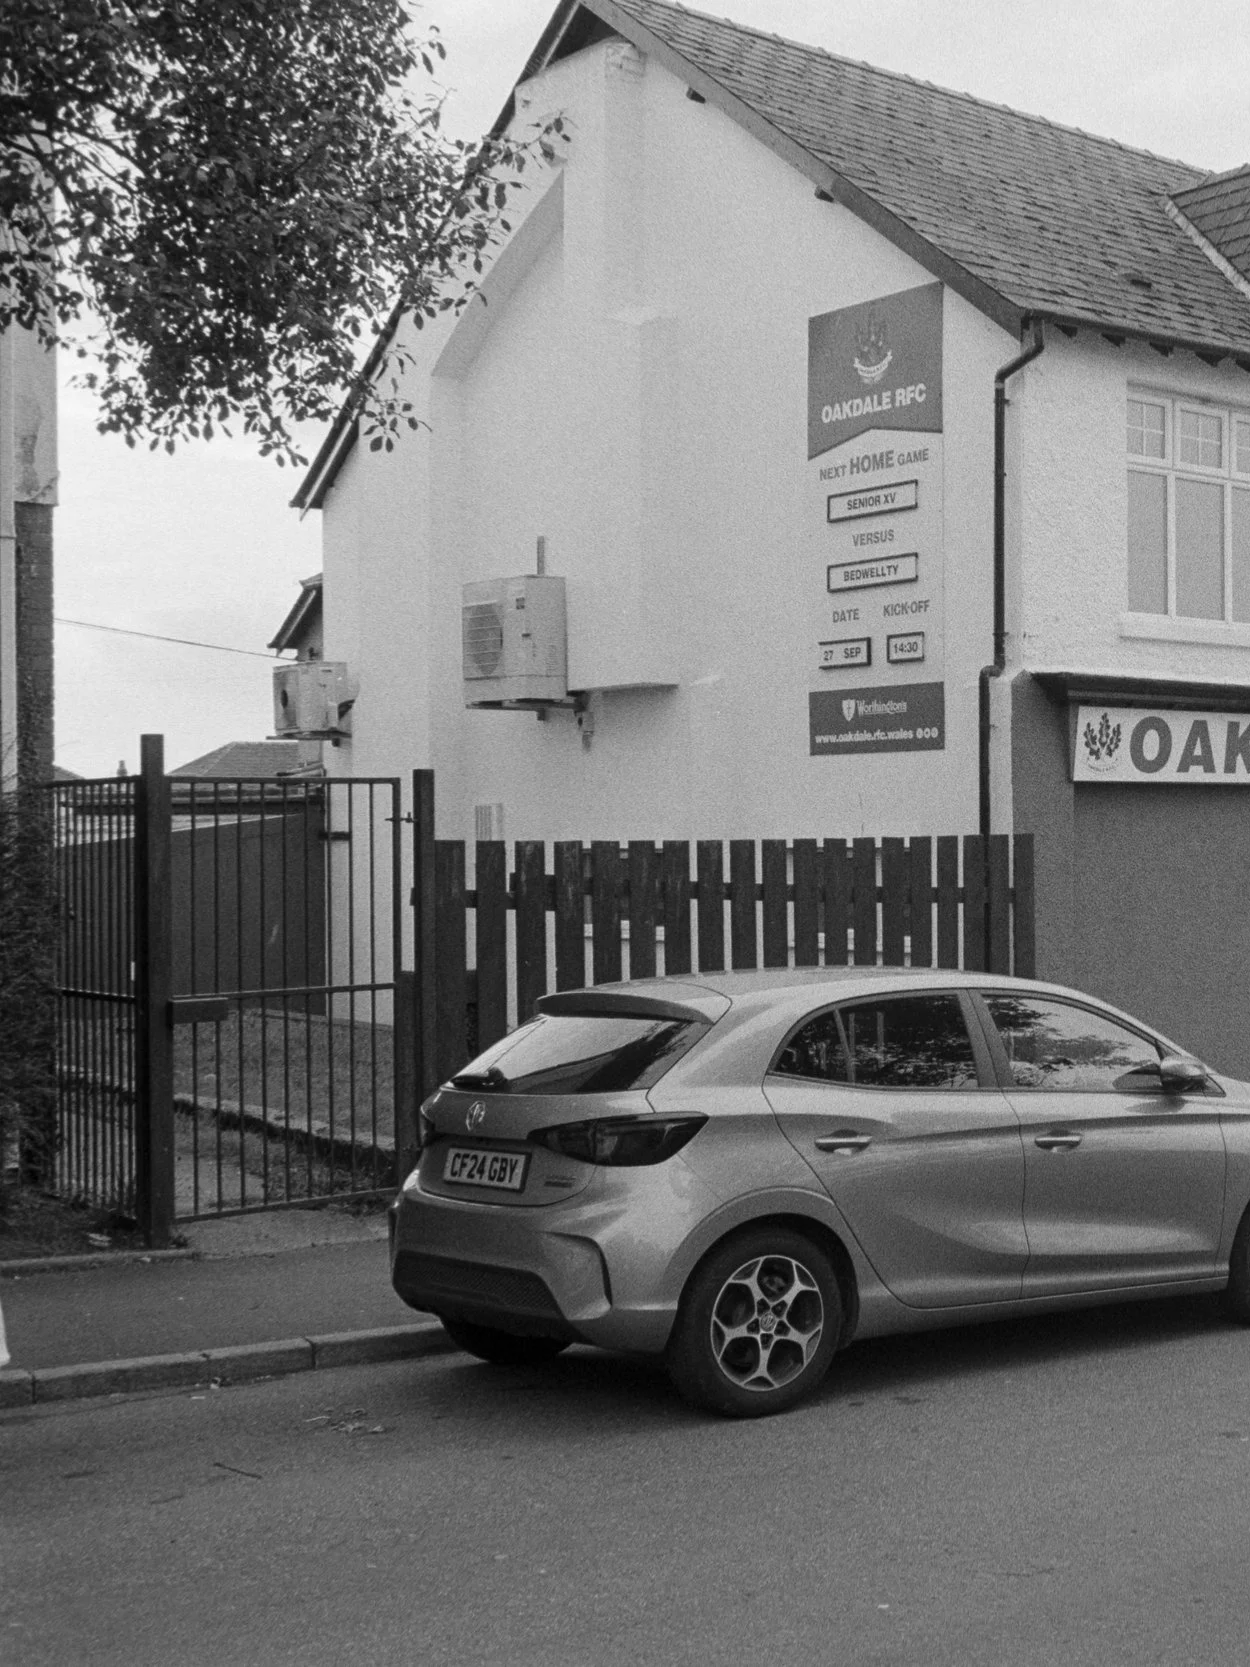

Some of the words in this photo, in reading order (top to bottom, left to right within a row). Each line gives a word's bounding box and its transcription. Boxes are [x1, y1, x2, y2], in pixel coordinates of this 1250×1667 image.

[821, 391, 892, 424] OAKDALE
[895, 383, 927, 408] RFC
[819, 464, 848, 482] NEXT
[850, 450, 895, 476] HOME
[897, 448, 930, 467] GAME
[847, 494, 881, 511] SENIOR
[883, 492, 897, 505] XV
[852, 529, 895, 547] VERSUS
[843, 564, 899, 582] BEDWELLTY
[832, 608, 860, 623] DATE
[823, 650, 834, 662] 27
[843, 647, 861, 659] SEP
[893, 641, 919, 654] 14:30
[815, 729, 914, 744] www.oakdale.rfc.wales
[450, 1152, 487, 1180] CF24
[488, 1156, 519, 1184] GBY
